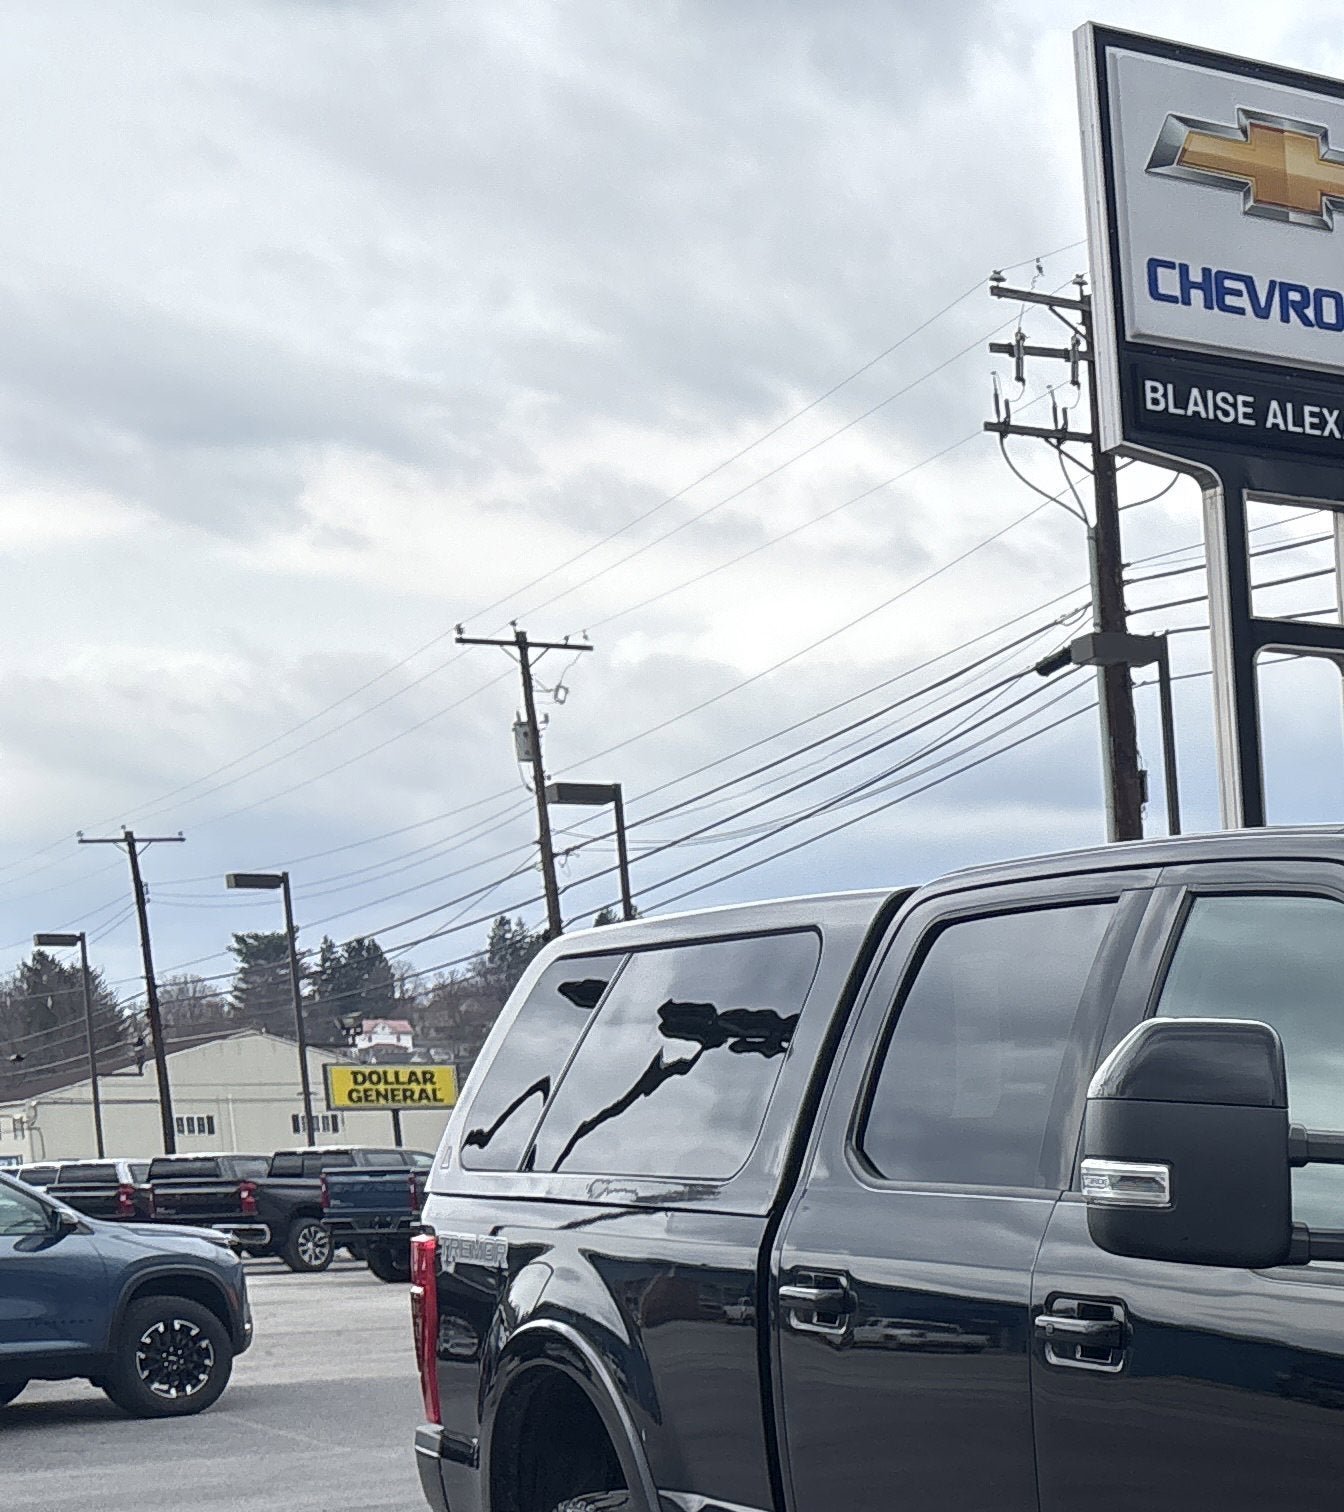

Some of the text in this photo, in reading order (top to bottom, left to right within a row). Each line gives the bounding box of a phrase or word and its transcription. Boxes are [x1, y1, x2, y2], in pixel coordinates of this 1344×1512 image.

[1143, 379, 1256, 427] BLAISE
[350, 1070, 437, 1086] DOLLAR
[347, 1087, 445, 1104] GENERAL
[438, 1235, 508, 1266] TREMOR
